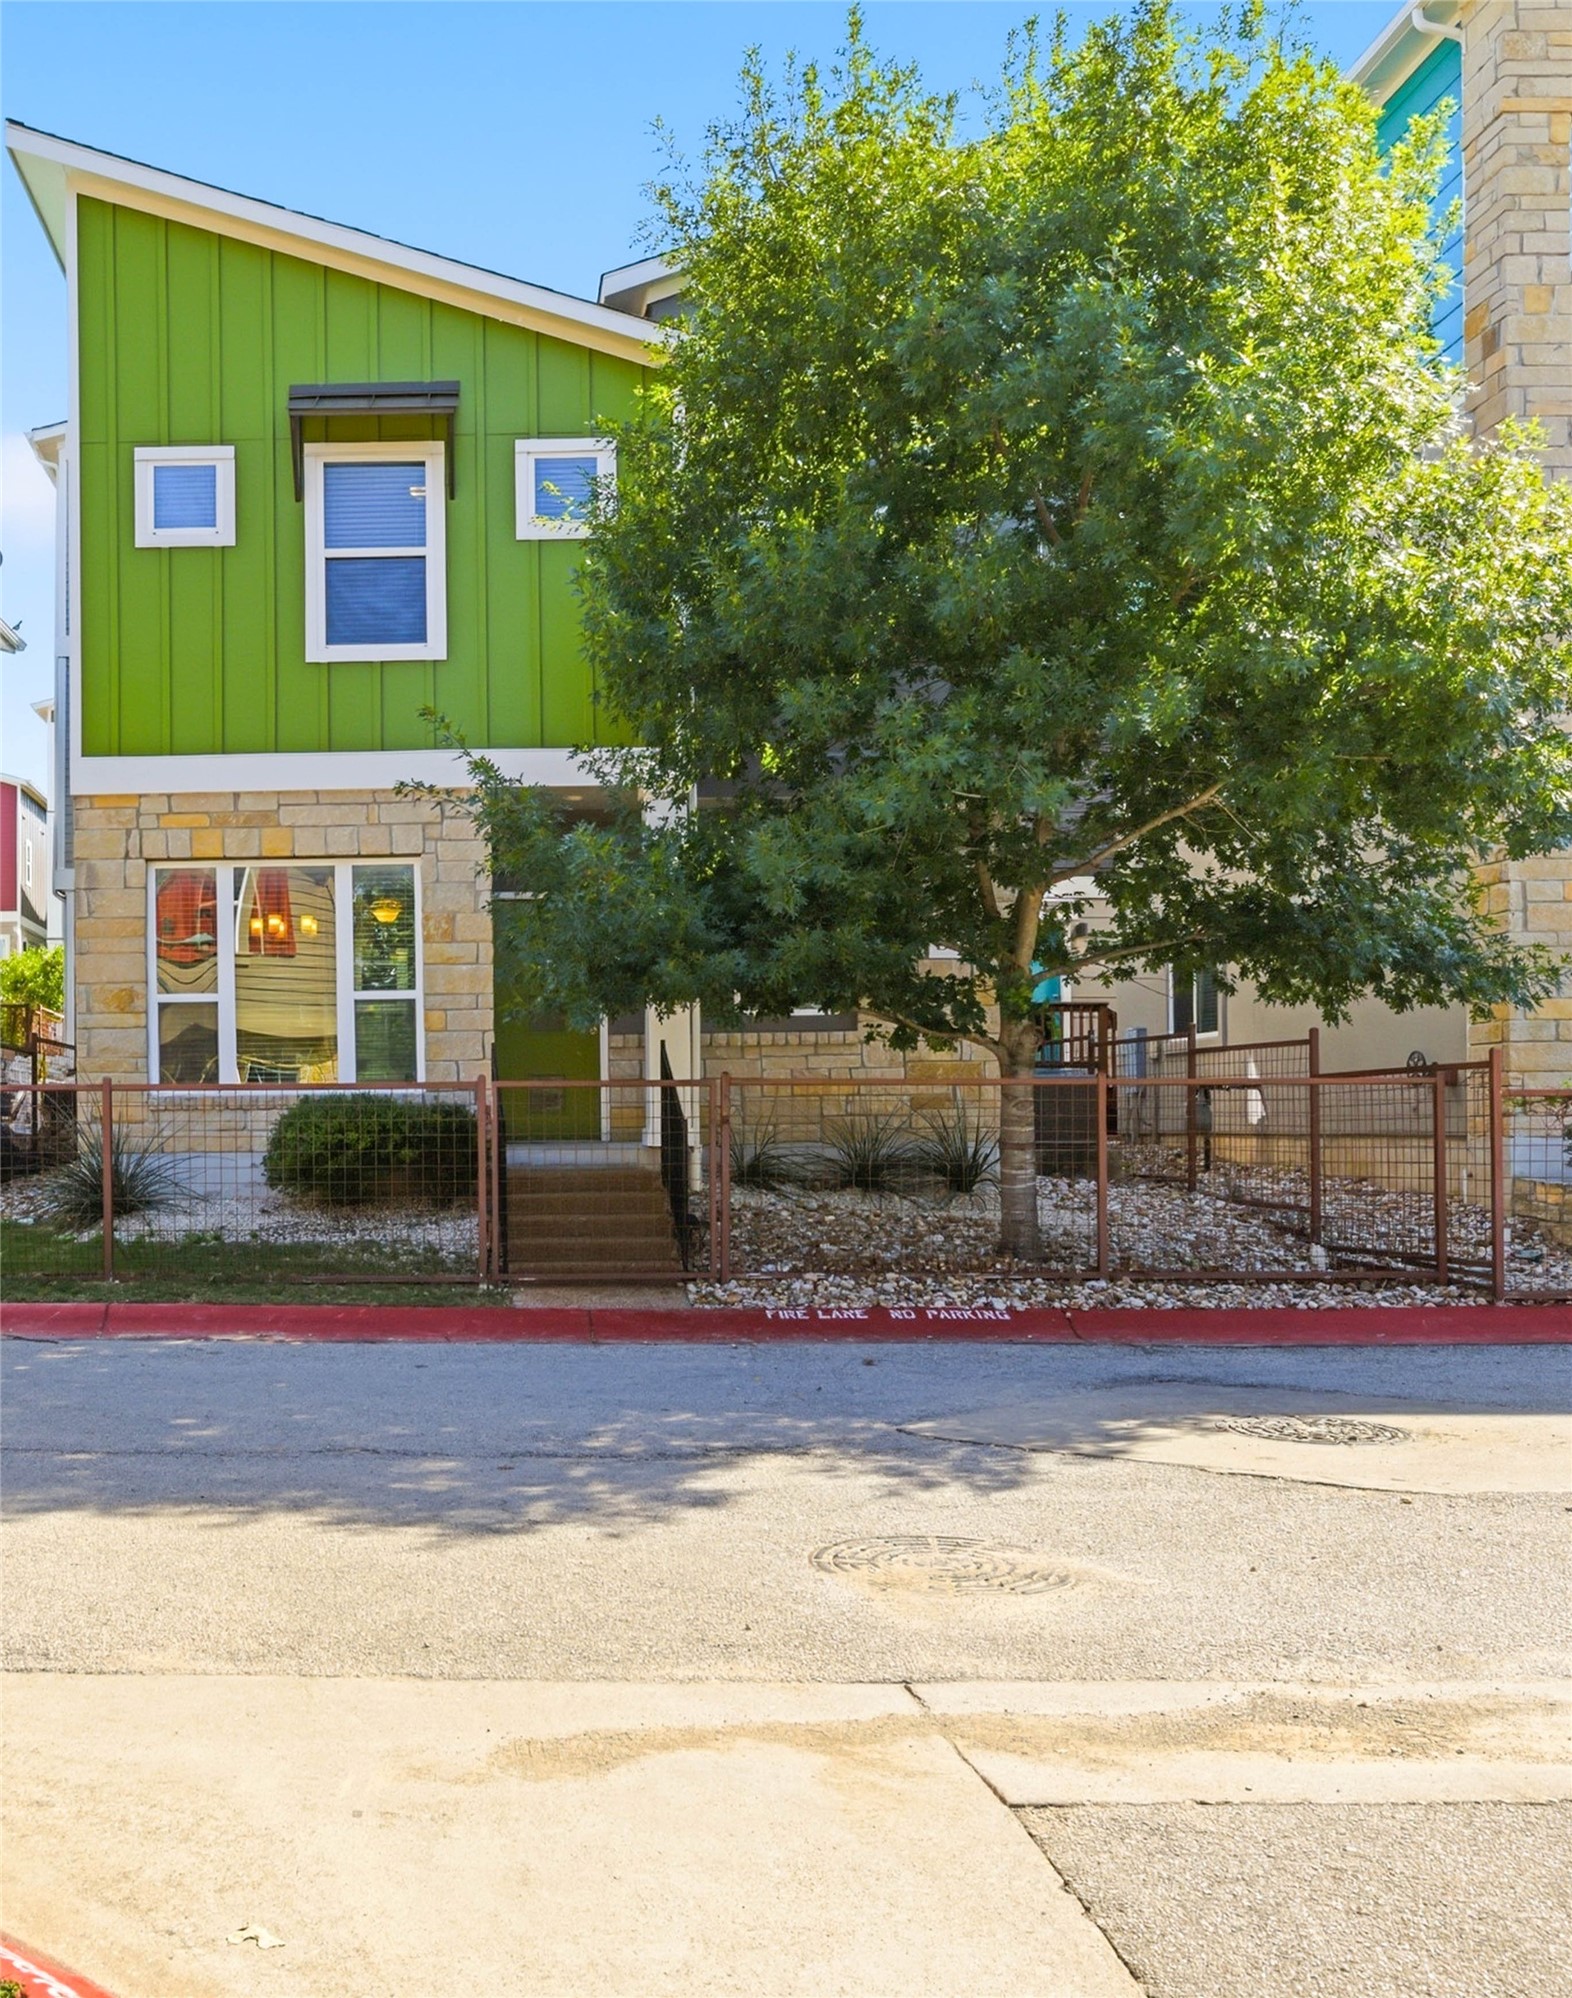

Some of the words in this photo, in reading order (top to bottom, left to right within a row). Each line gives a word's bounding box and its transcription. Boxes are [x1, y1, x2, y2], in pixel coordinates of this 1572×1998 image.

[765, 1309, 810, 1319] FIRE
[817, 1309, 869, 1319] LANE
[889, 1309, 916, 1319] NO
[926, 1309, 1011, 1320] PARKING
